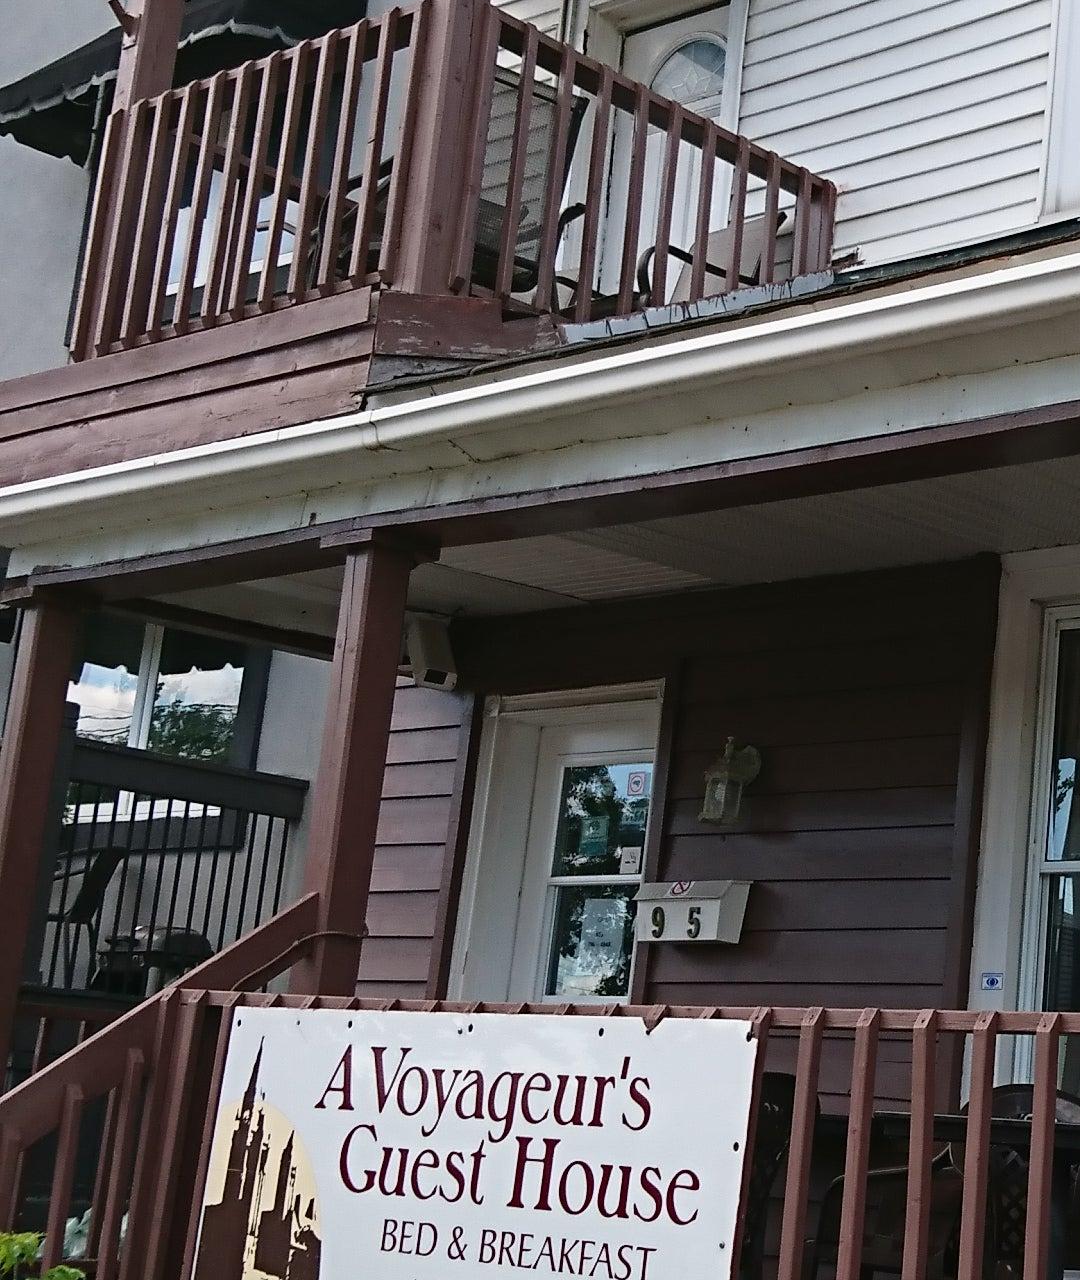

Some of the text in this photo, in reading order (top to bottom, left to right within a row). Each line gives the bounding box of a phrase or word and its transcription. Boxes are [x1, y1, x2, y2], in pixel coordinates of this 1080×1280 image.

[315, 1044, 652, 1143] A Voyageur's
[339, 1124, 701, 1226] Guest House
[380, 1219, 438, 1258] BED
[447, 1227, 468, 1261] &
